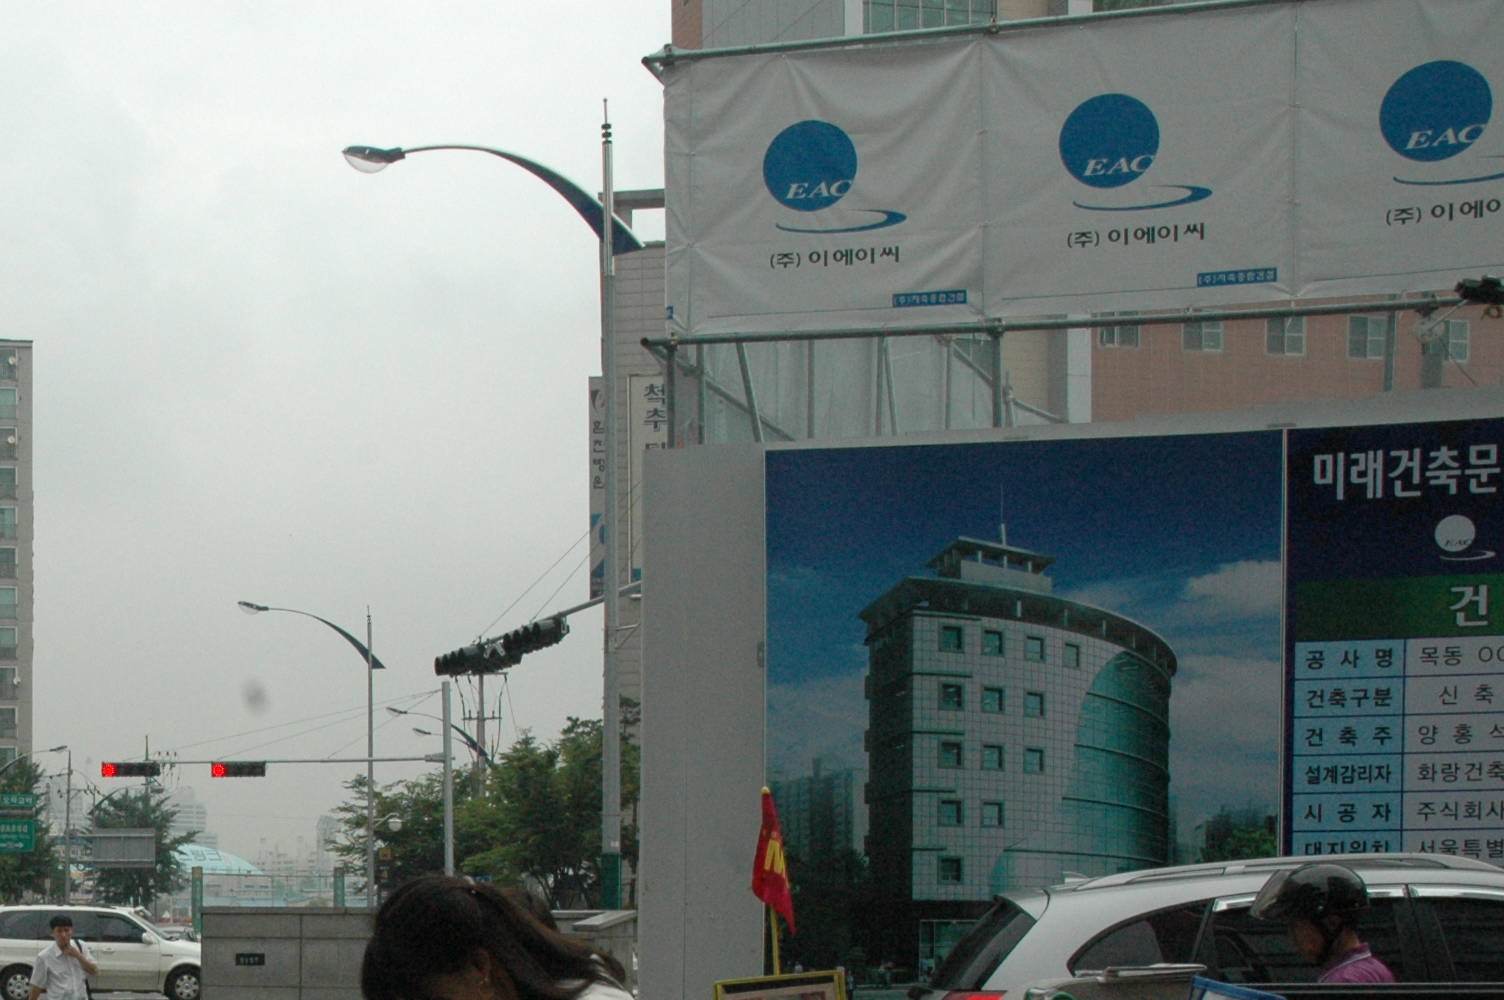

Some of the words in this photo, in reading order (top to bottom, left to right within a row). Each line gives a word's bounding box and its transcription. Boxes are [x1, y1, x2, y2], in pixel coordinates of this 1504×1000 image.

[1404, 123, 1488, 152] EAC
[1083, 154, 1156, 178] EAC
[785, 179, 853, 201] EAC
[1386, 207, 1422, 227] (주)
[1067, 229, 1100, 250] (주)
[1108, 222, 1205, 245] 이에이씨
[769, 250, 801, 270] (주)
[809, 245, 900, 268] 이에이씨
[1419, 646, 1463, 667] 목동
[1306, 686, 1393, 709] 건축구분
[1305, 763, 1391, 785] 설계감리자
